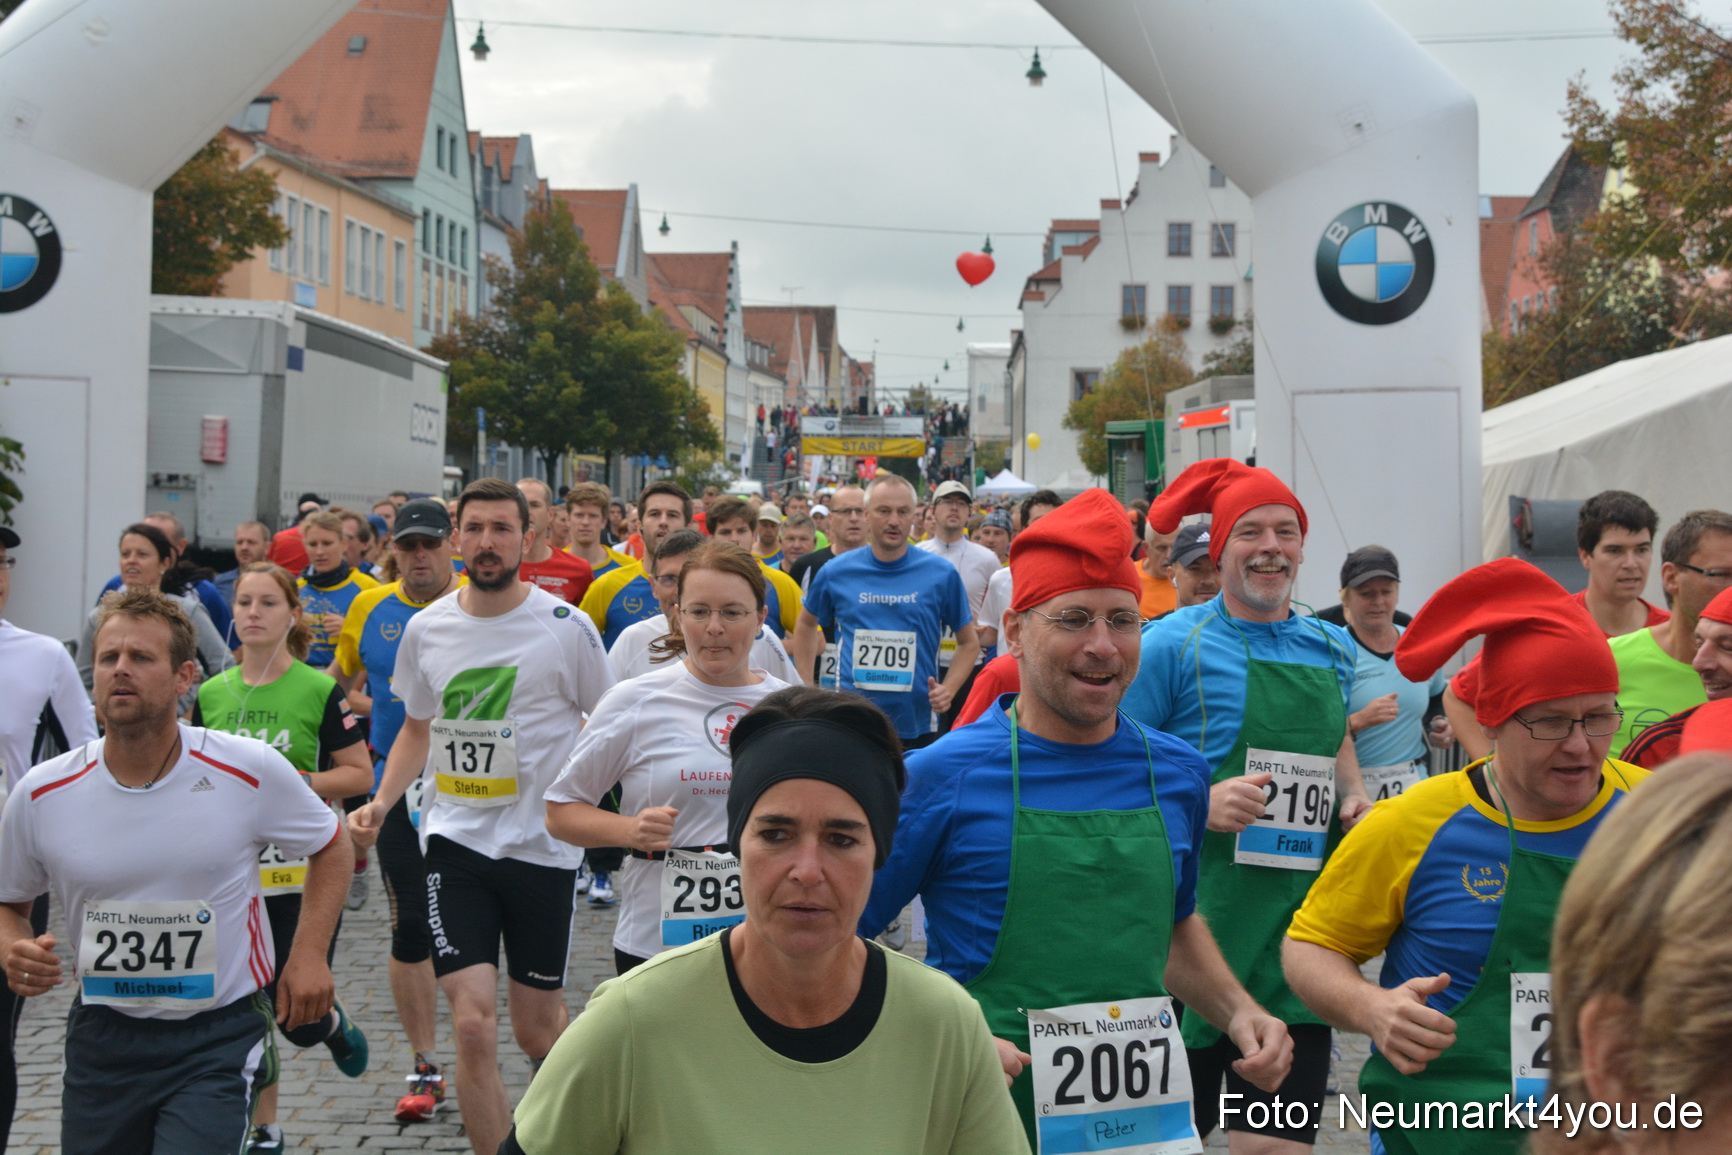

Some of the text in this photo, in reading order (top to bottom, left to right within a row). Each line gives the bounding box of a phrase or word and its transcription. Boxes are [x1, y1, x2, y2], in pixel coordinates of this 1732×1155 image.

[1325, 203, 1427, 246] BMW
[841, 441, 884, 453] START
[859, 591, 917, 606] Sinupret
[858, 644, 910, 668] 2709
[865, 671, 899, 683] Günther
[454, 728, 497, 738] Neumarkt
[445, 740, 495, 773] 137
[1248, 760, 1288, 775] PARTL
[189, 785, 216, 793] adidas
[454, 780, 489, 796] Stefan
[692, 787, 706, 795] Dr.
[1256, 779, 1330, 827] 2196
[1276, 834, 1314, 854] Frank
[665, 859, 703, 871] PARTL
[1479, 867, 1492, 876] 15
[271, 872, 292, 884] Eva
[1473, 878, 1501, 887] Jahre
[86, 911, 191, 924] PARTL Neumarkt
[426, 872, 455, 957] Sinupret
[93, 930, 203, 972] 2347
[114, 981, 183, 995] Michael
[1033, 1021, 1093, 1038] PARTL
[1052, 1037, 1171, 1106] 2067
[1042, 1103, 1050, 1115] C
[1094, 1118, 1137, 1143] Peter
